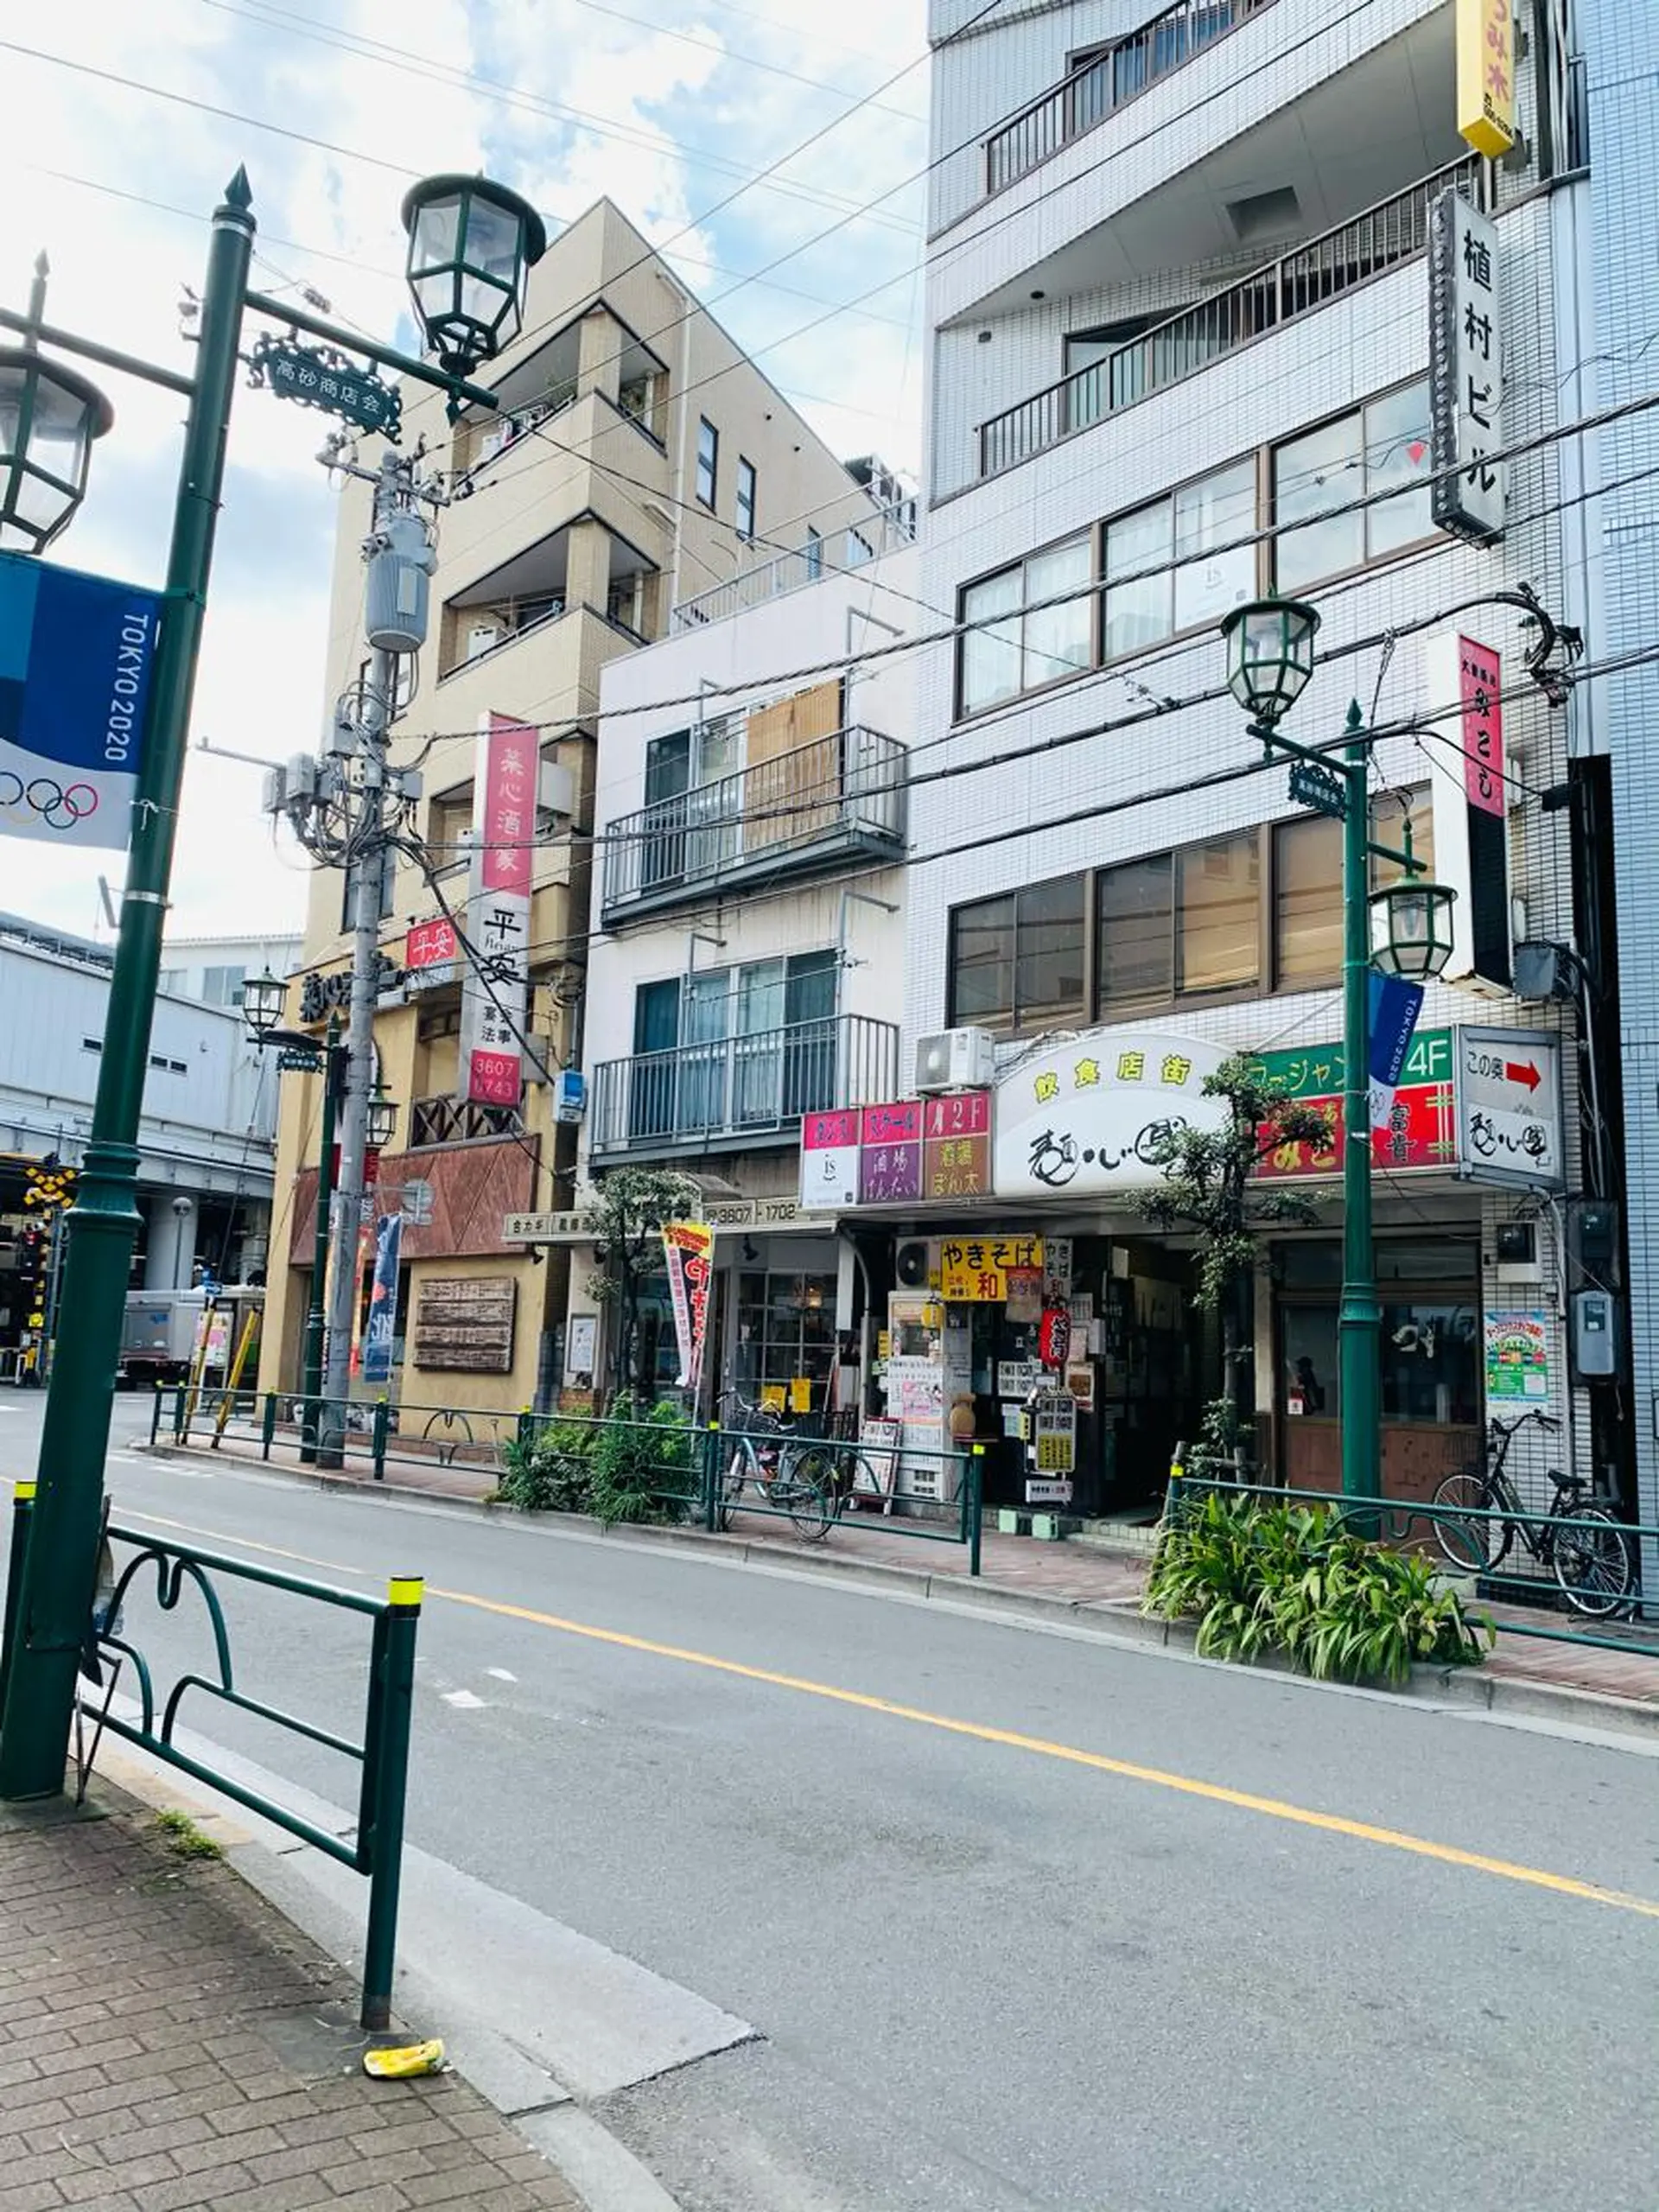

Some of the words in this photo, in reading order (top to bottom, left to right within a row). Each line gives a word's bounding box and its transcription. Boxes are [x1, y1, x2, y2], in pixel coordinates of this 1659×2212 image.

[1464, 226, 1496, 493] 植村ビル
[276, 358, 379, 413] 高砂商店会
[114, 614, 149, 695] TOKYO
[105, 699, 136, 761] 2020
[412, 923, 452, 963] 平安
[484, 909, 522, 986] 平安
[1397, 999, 1418, 1044] TOKYO
[1033, 1052, 1192, 1103] 飲食店街
[1389, 1046, 1403, 1081] 2020
[1407, 1039, 1448, 1077] 4F
[1467, 1051, 1504, 1081] この奥
[952, 1097, 983, 1129] 2F
[823, 1153, 836, 1176] is
[874, 1146, 908, 1173] 酒場
[944, 1243, 1036, 1270] やきそば
[977, 1271, 998, 1299] 和
